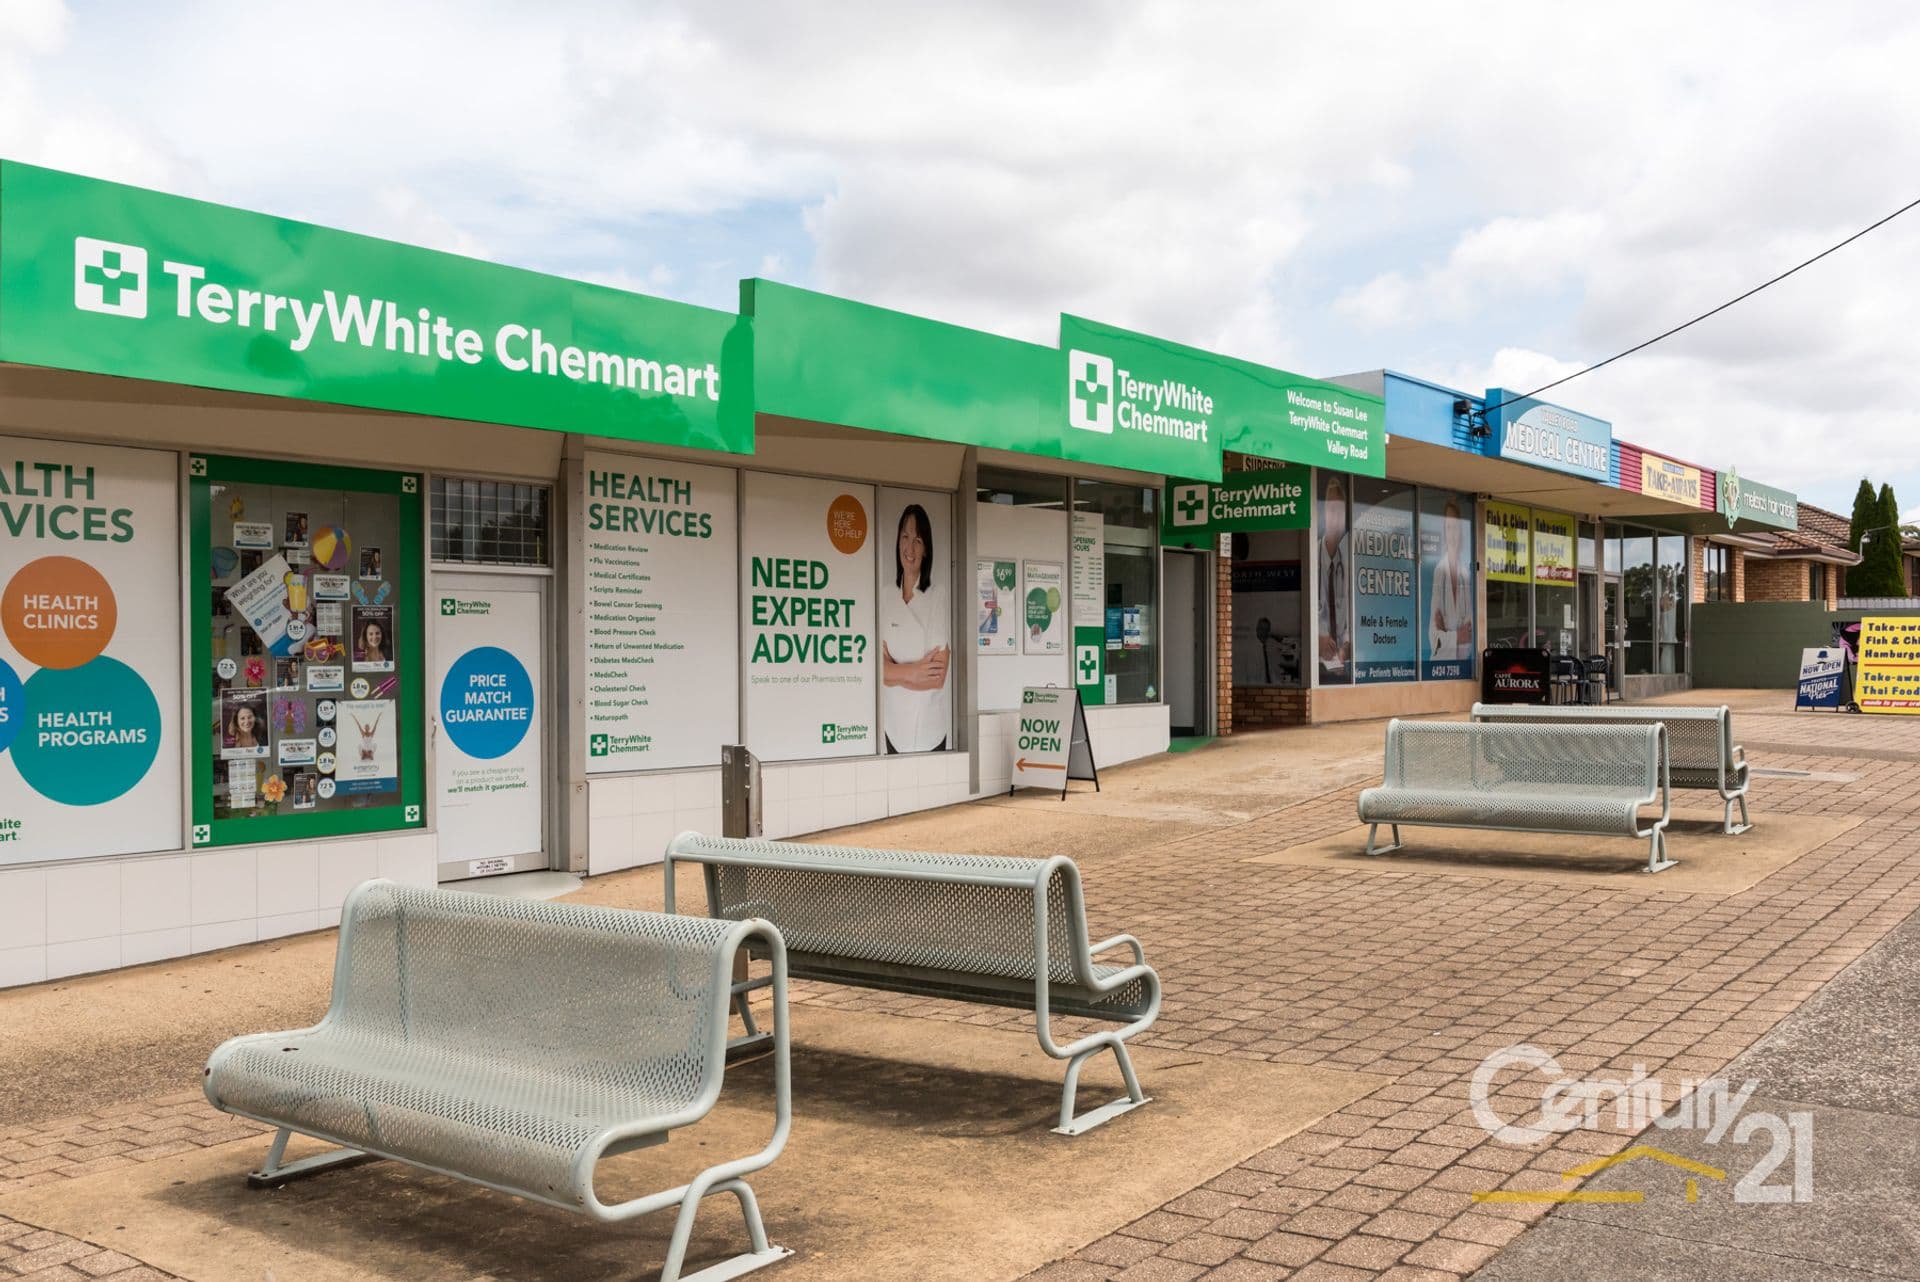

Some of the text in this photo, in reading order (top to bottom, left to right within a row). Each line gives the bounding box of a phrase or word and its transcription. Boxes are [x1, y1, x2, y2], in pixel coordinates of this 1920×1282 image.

[163, 259, 719, 403] TerryWhite Chemmart
[1117, 369, 1213, 415] TerryWhite
[1287, 389, 1368, 421] Welcome to Susan Lee
[1117, 400, 1208, 442] Chemmart
[1289, 411, 1368, 440] TerryWhite Chemmart
[1326, 439, 1368, 460] Valley Road
[1506, 421, 1607, 472] MEDICAL CENTRE
[589, 470, 692, 506] HEALTH
[1212, 483, 1302, 505] TerryWhite
[833, 511, 857, 521] WE'RE
[1211, 500, 1297, 520] Chemmart
[0, 501, 135, 543] VICES
[588, 502, 713, 539] SERVICES
[833, 520, 852, 529] HERE
[1503, 512, 1509, 528] &
[833, 527, 863, 539] TO HELP
[1352, 528, 1416, 561] MEDICAL
[751, 556, 830, 590] NEED
[1357, 566, 1411, 597] CENTRE
[23, 594, 99, 611] HEALTH
[456, 600, 491, 609] TerryWhite
[456, 607, 490, 615] Chemmart
[751, 595, 856, 628] EXPERT
[23, 613, 99, 630] CLINICS
[1360, 615, 1409, 628] Male & Female
[1372, 633, 1397, 645] Doctors
[1865, 636, 1888, 645] Fish
[1891, 636, 1900, 645] &
[751, 633, 867, 664] ADVICE?
[1865, 649, 1920, 660] Hamburge
[1802, 660, 1842, 675] NOW OPEN
[469, 674, 507, 688] PRICE
[1494, 678, 1541, 689] AURORA
[1800, 678, 1839, 695] NATIONAL
[464, 691, 512, 705] MATCH
[1862, 686, 1920, 695] Thai Food
[37, 711, 113, 728] HEALTH
[445, 707, 528, 723] GUARANTEE
[836, 725, 869, 734] TerryWhite
[1020, 718, 1060, 734] NOW
[37, 728, 147, 747] PROGRAMS
[609, 735, 652, 745] TerryWhite
[836, 732, 867, 740] Chemmart
[1018, 735, 1062, 752] OPEN
[609, 744, 650, 753] Chemmart
